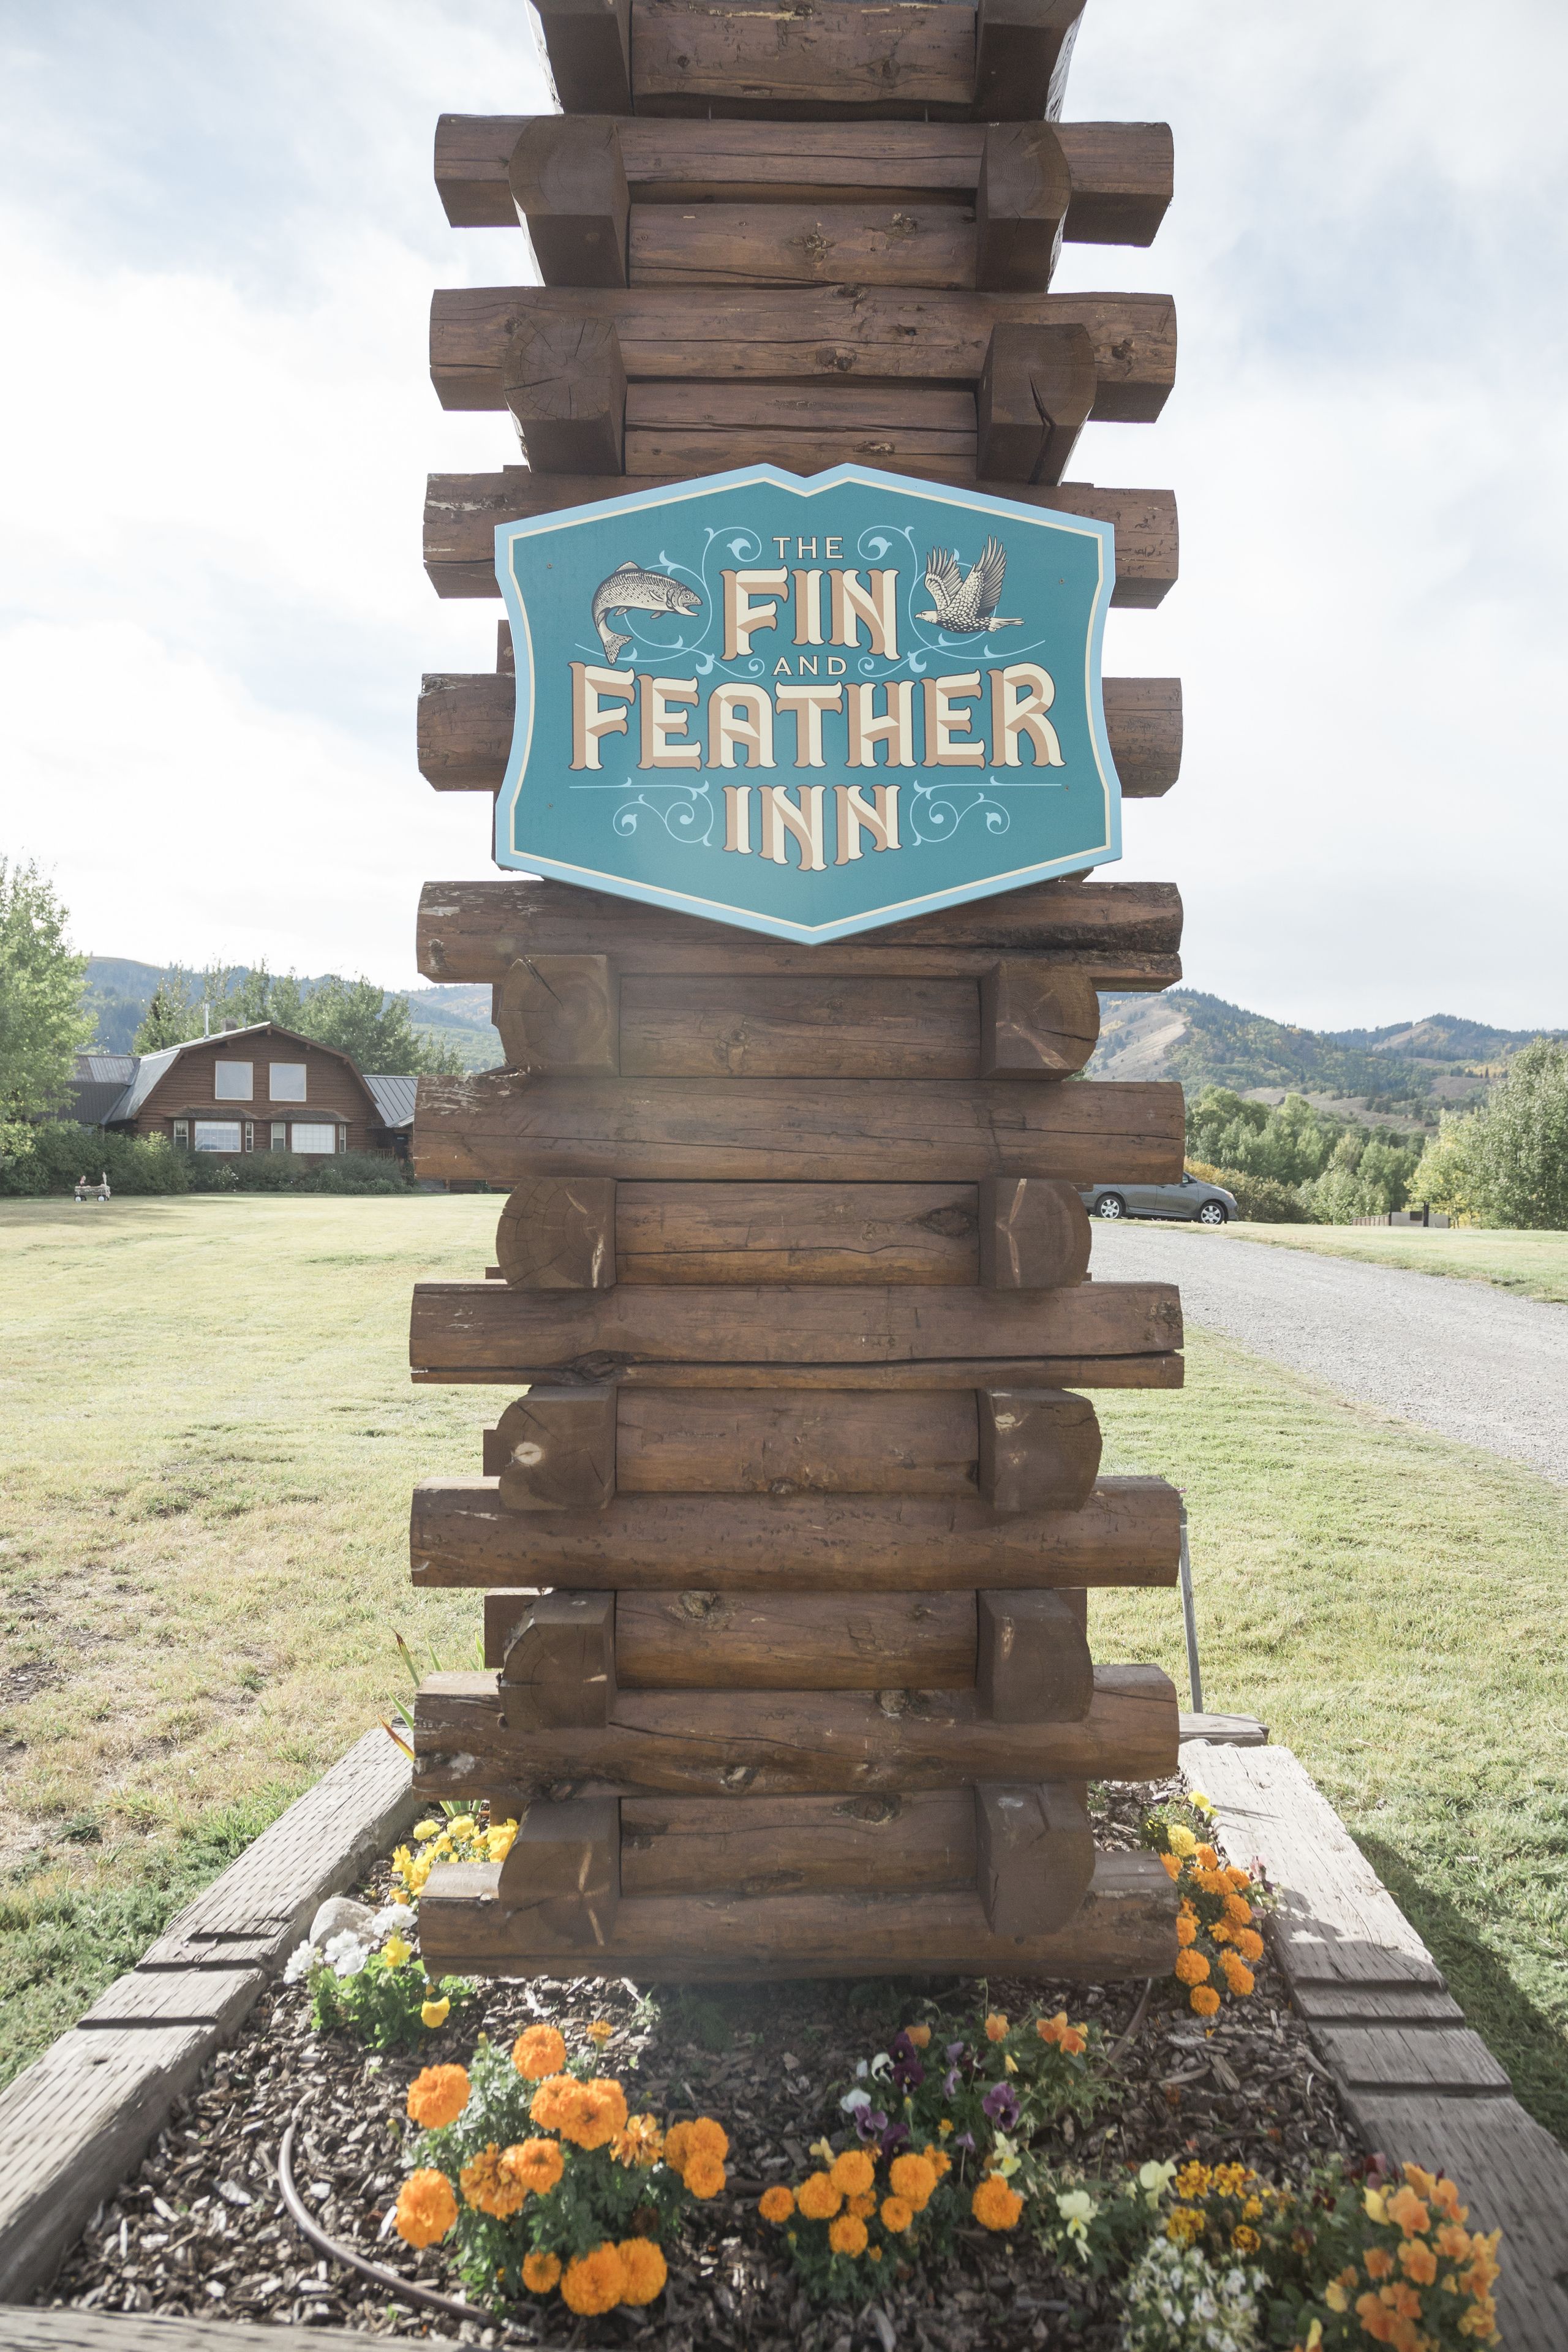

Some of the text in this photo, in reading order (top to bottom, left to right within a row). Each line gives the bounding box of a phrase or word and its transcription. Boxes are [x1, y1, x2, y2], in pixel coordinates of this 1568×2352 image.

[772, 537, 844, 560] THE
[720, 565, 902, 662] FIN
[772, 655, 848, 677] AND
[568, 661, 1067, 772] FEATHER
[721, 784, 903, 872] INN
